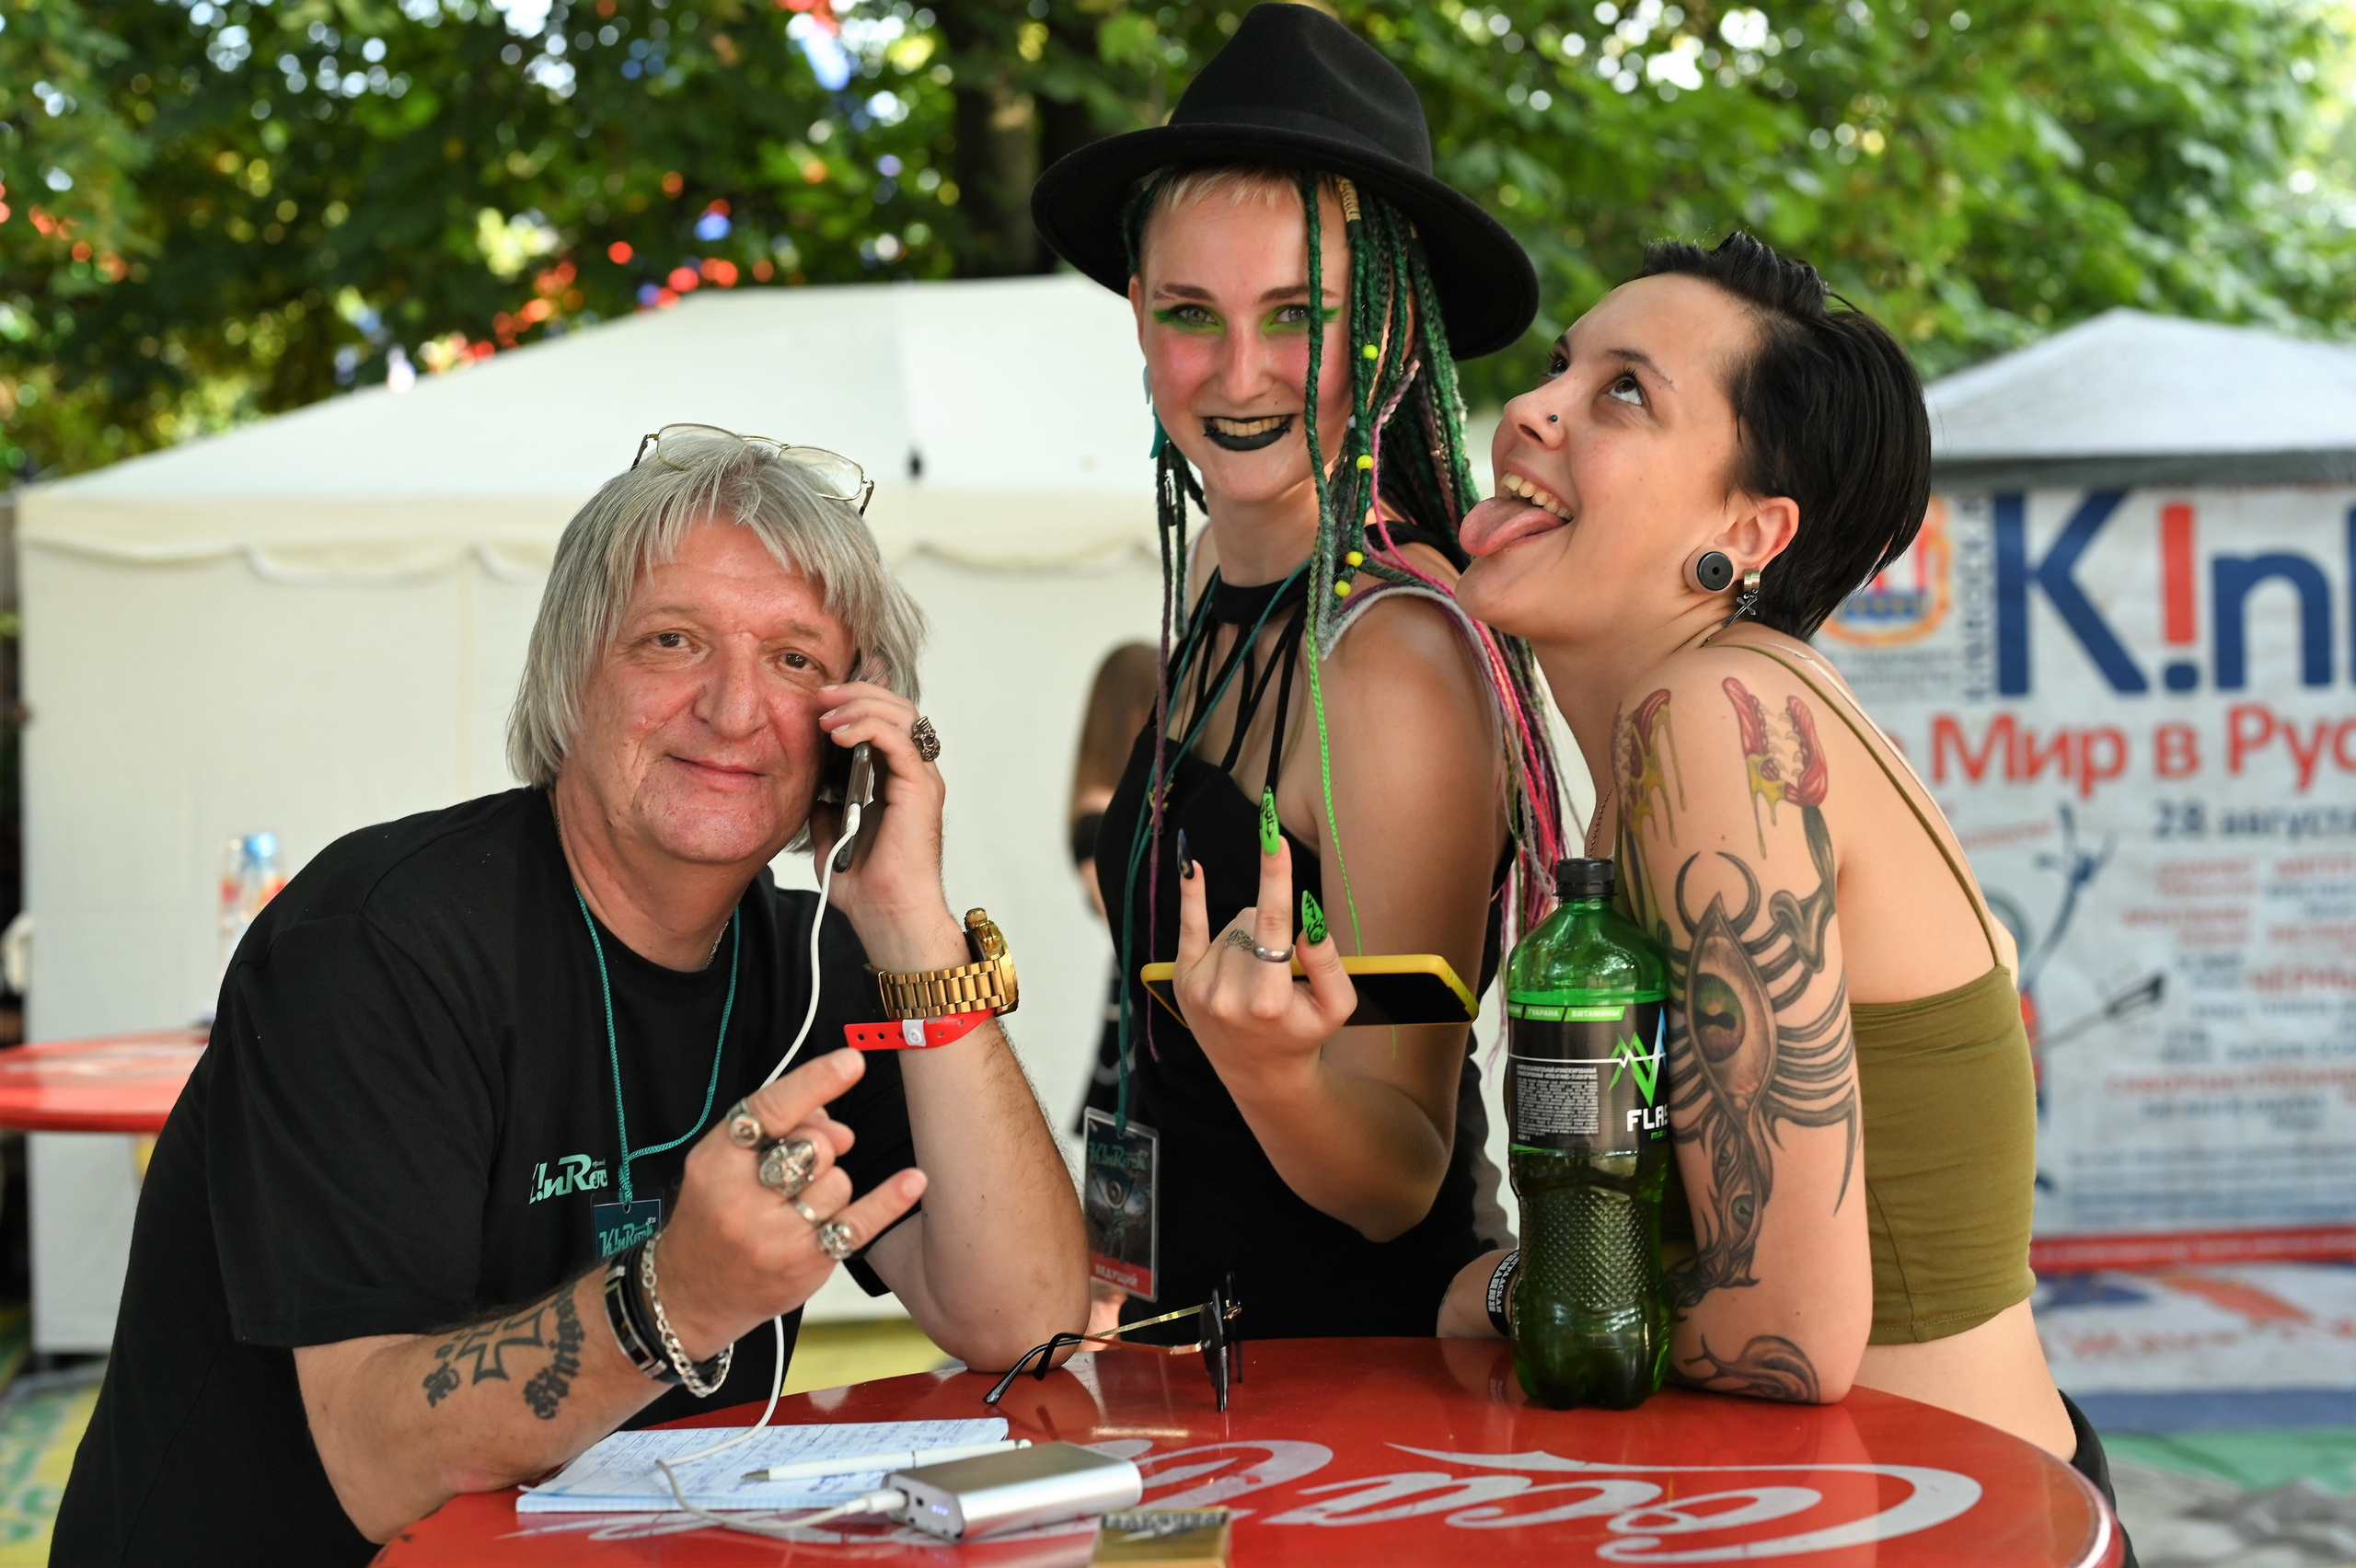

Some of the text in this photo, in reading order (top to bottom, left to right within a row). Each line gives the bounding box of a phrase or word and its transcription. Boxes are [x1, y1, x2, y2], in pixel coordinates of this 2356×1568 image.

[1992, 488, 2356, 697] K!n
[1932, 703, 2356, 799] Мир в Рус
[1571, 1009, 1621, 1018] ВИТАМИНЫ
[1094, 1263, 1138, 1288] ВЕДУЩИЙ
[1261, 1441, 1983, 1562] Coca
